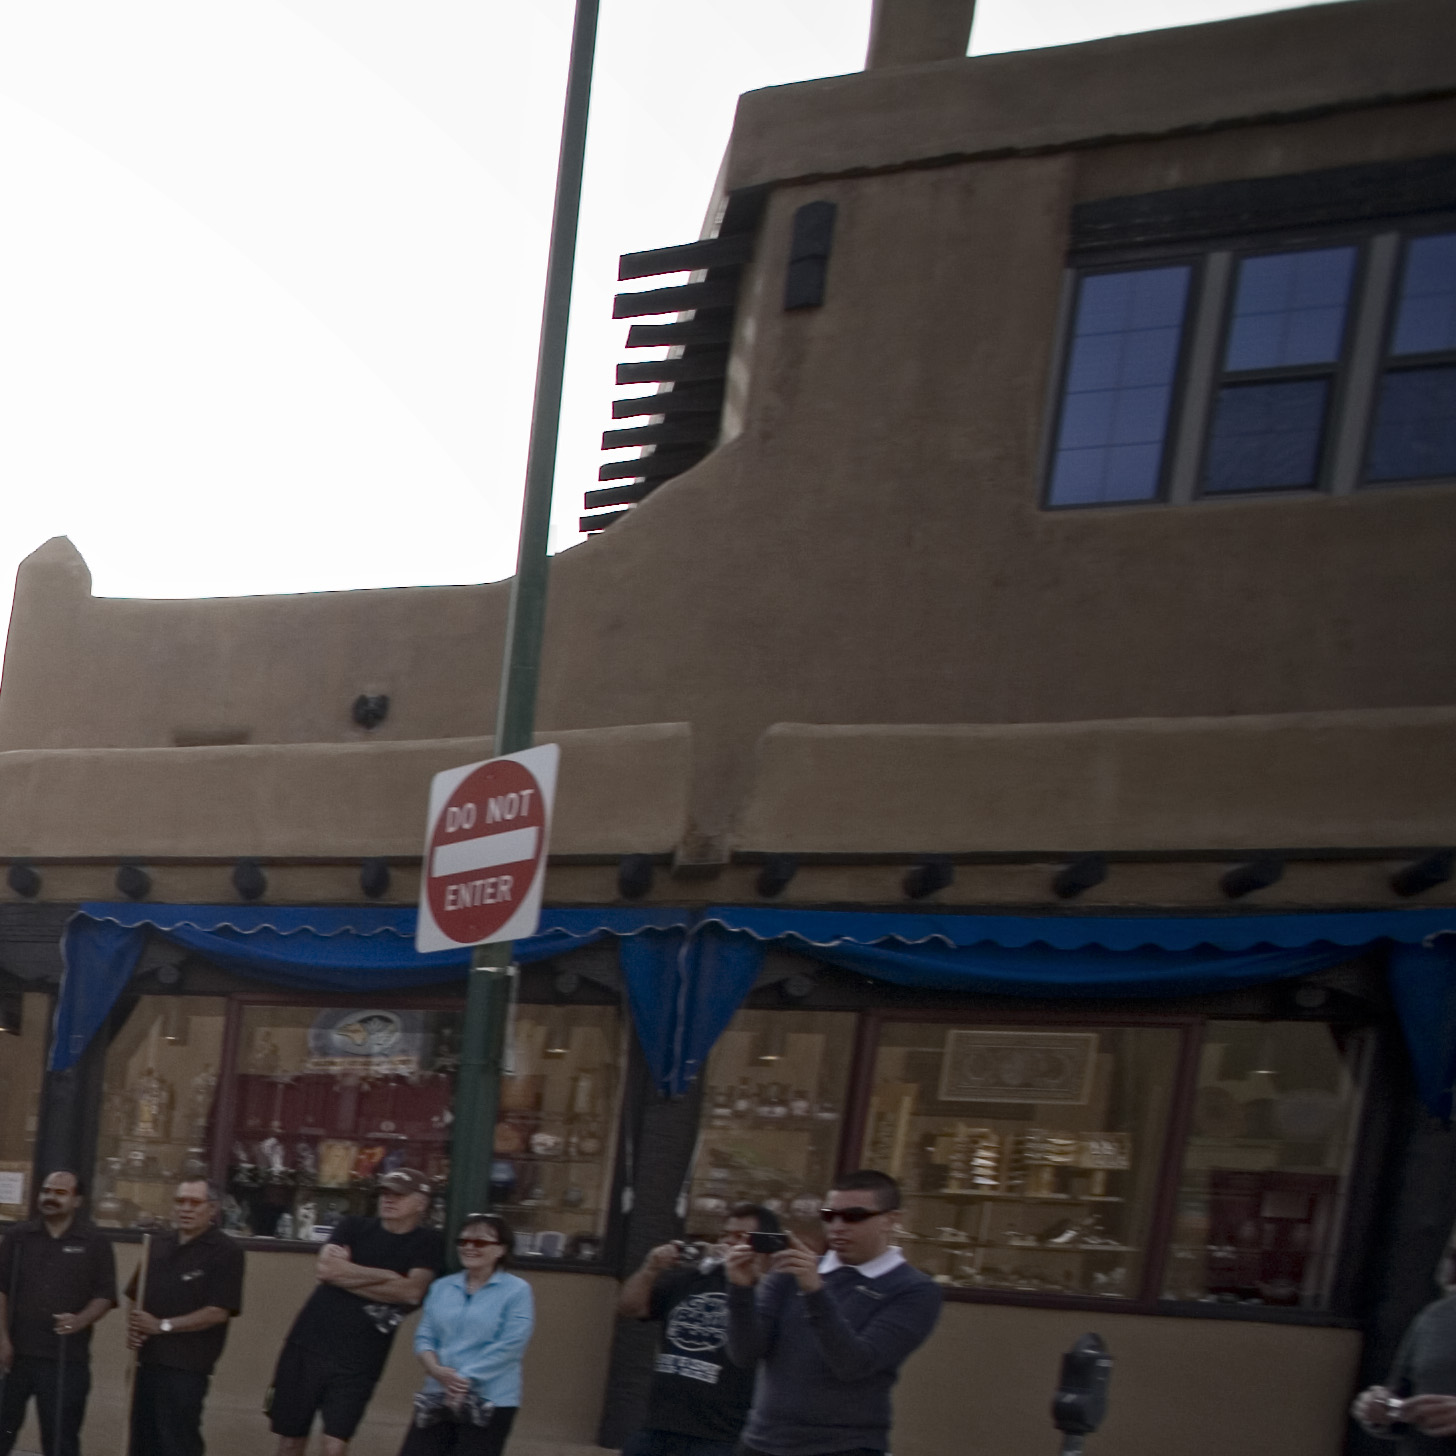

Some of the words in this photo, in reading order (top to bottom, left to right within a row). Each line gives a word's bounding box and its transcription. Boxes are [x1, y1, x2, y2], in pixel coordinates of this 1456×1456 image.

[445, 802, 477, 833] DO
[485, 789, 535, 824] NOT
[444, 875, 514, 911] ENTER
